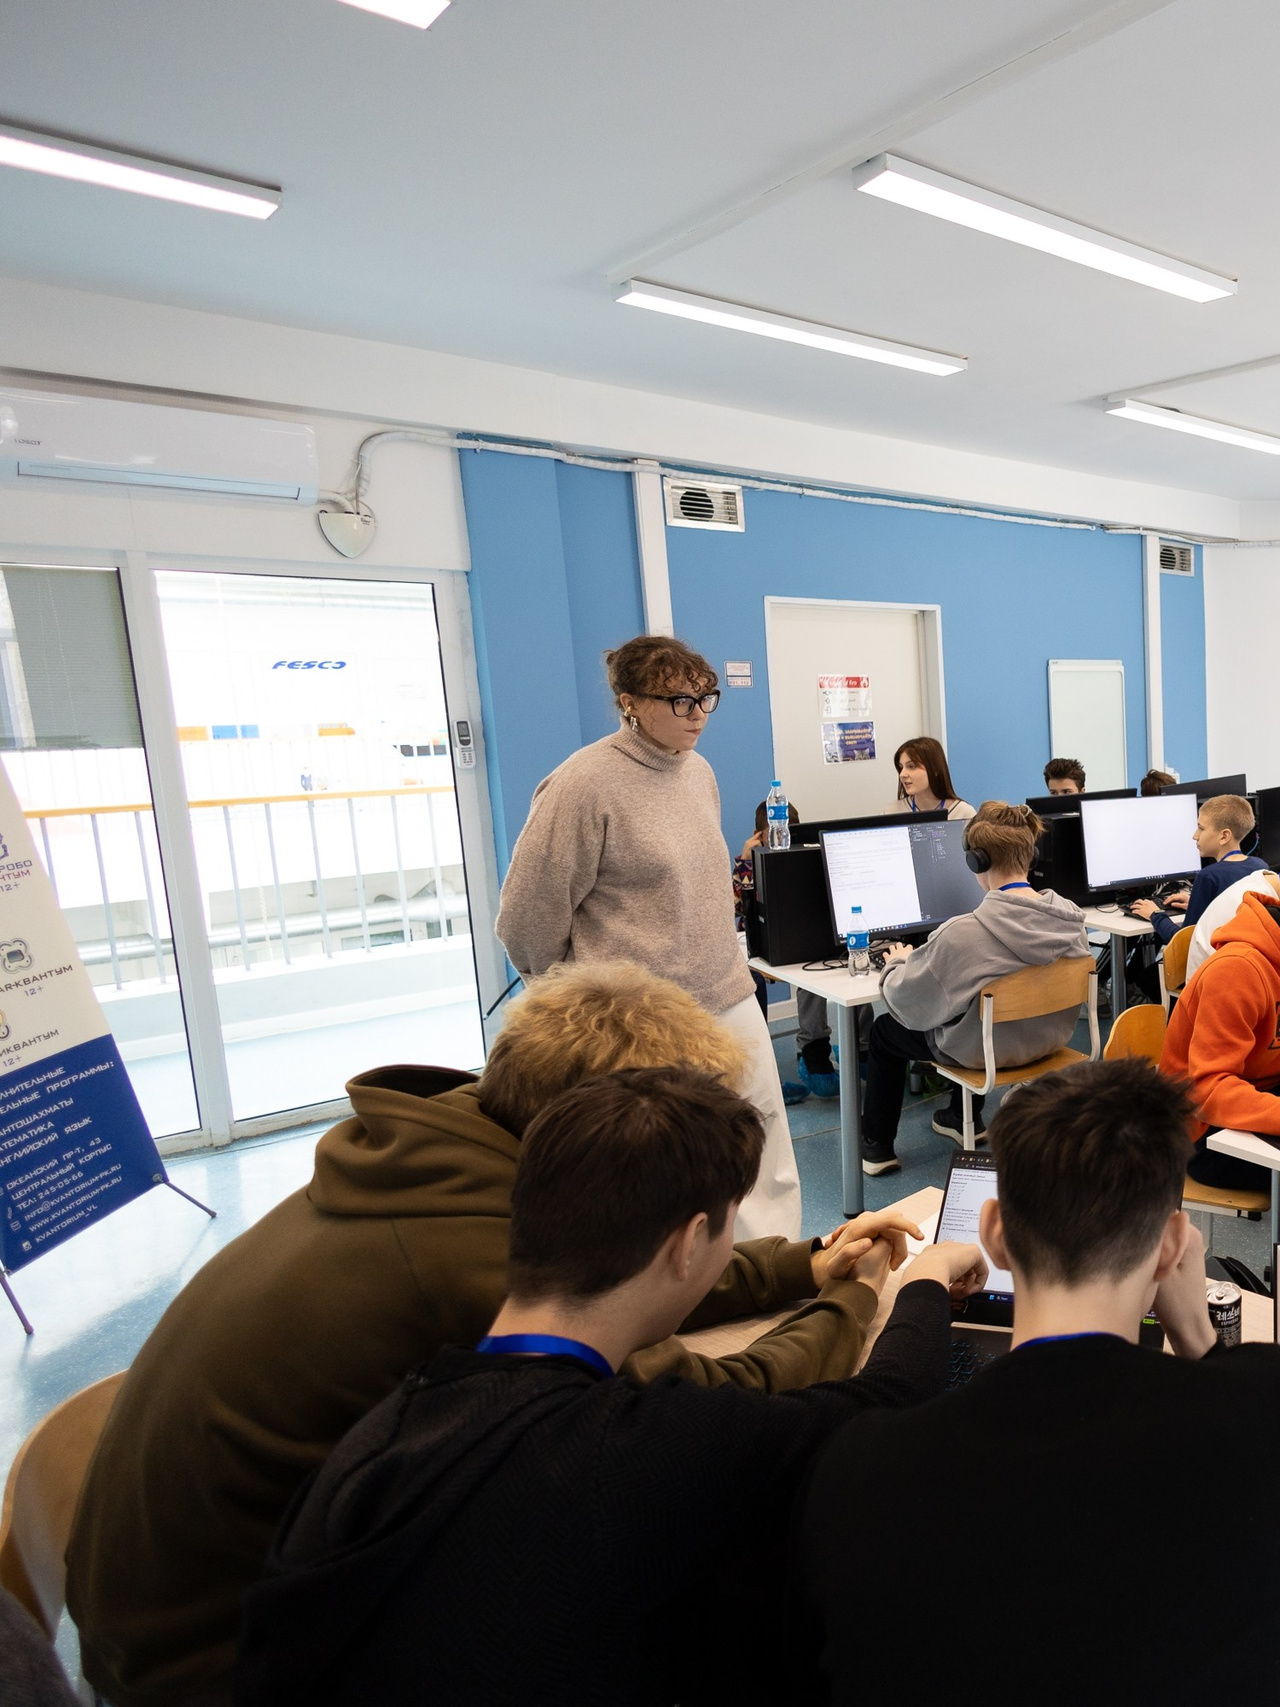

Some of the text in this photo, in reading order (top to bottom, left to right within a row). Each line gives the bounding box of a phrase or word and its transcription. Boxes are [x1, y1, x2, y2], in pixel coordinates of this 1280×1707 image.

[272, 660, 347, 670] FESCO
[24, 986, 44, 997] 12+
[3, 1055, 22, 1067] 12+
[46, 1061, 115, 1094] ПРОГРАММЫ:
[64, 1116, 93, 1135] ЯЗЫК
[6, 1158, 59, 1190] ОКЕАНСКИЙ
[89, 1137, 102, 1147] 43
[11, 1143, 113, 1201] ЦЕНТРАЛЬНЫЙ КОРПУС
[16, 1171, 84, 1211] ТЕЛ: 245-05-66
[24, 1163, 122, 1221] INFO@KVANTORIUM-PK.RU
[29, 1176, 123, 1232] WWW.KVANTORIUM-PK.RU
[35, 1204, 98, 1243] KVANTORIUM_VL
